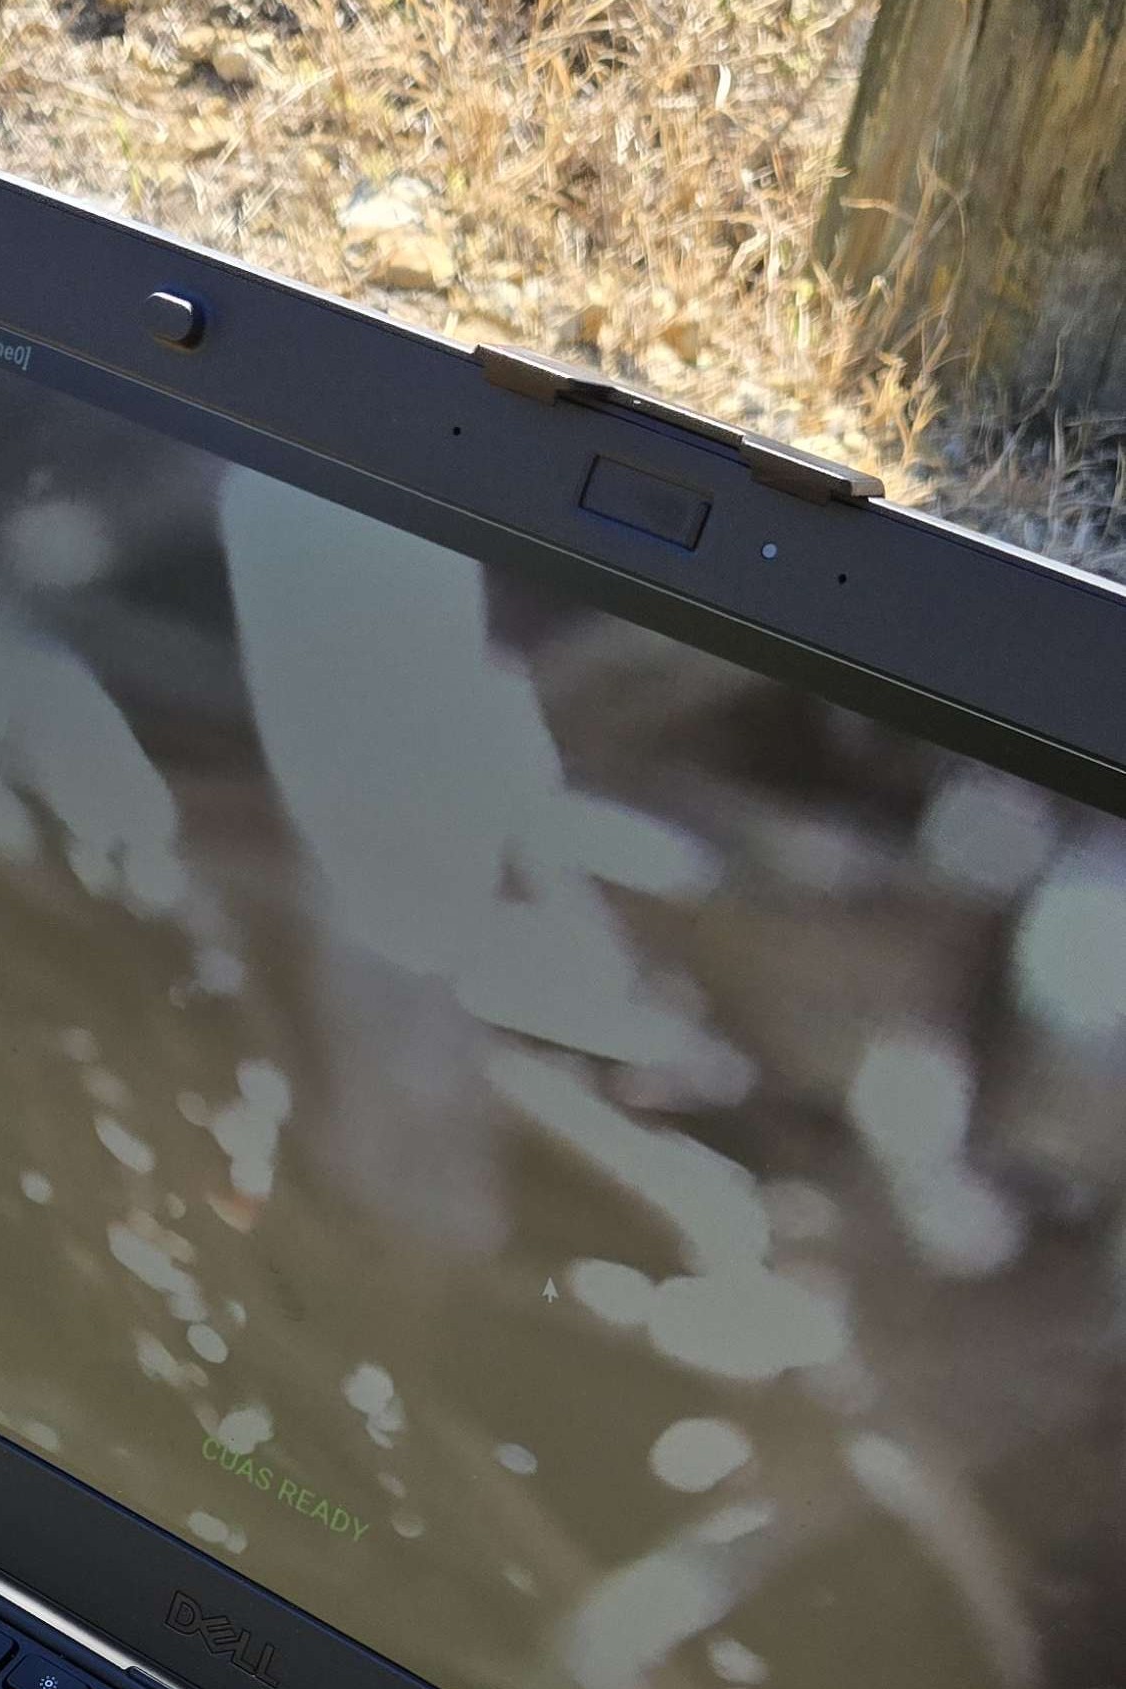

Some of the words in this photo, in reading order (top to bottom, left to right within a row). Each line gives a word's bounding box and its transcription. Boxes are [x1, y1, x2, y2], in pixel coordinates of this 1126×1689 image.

[202, 1438, 273, 1490] CUAS
[278, 1479, 369, 1542] READY
[163, 1590, 281, 1689] DELL
